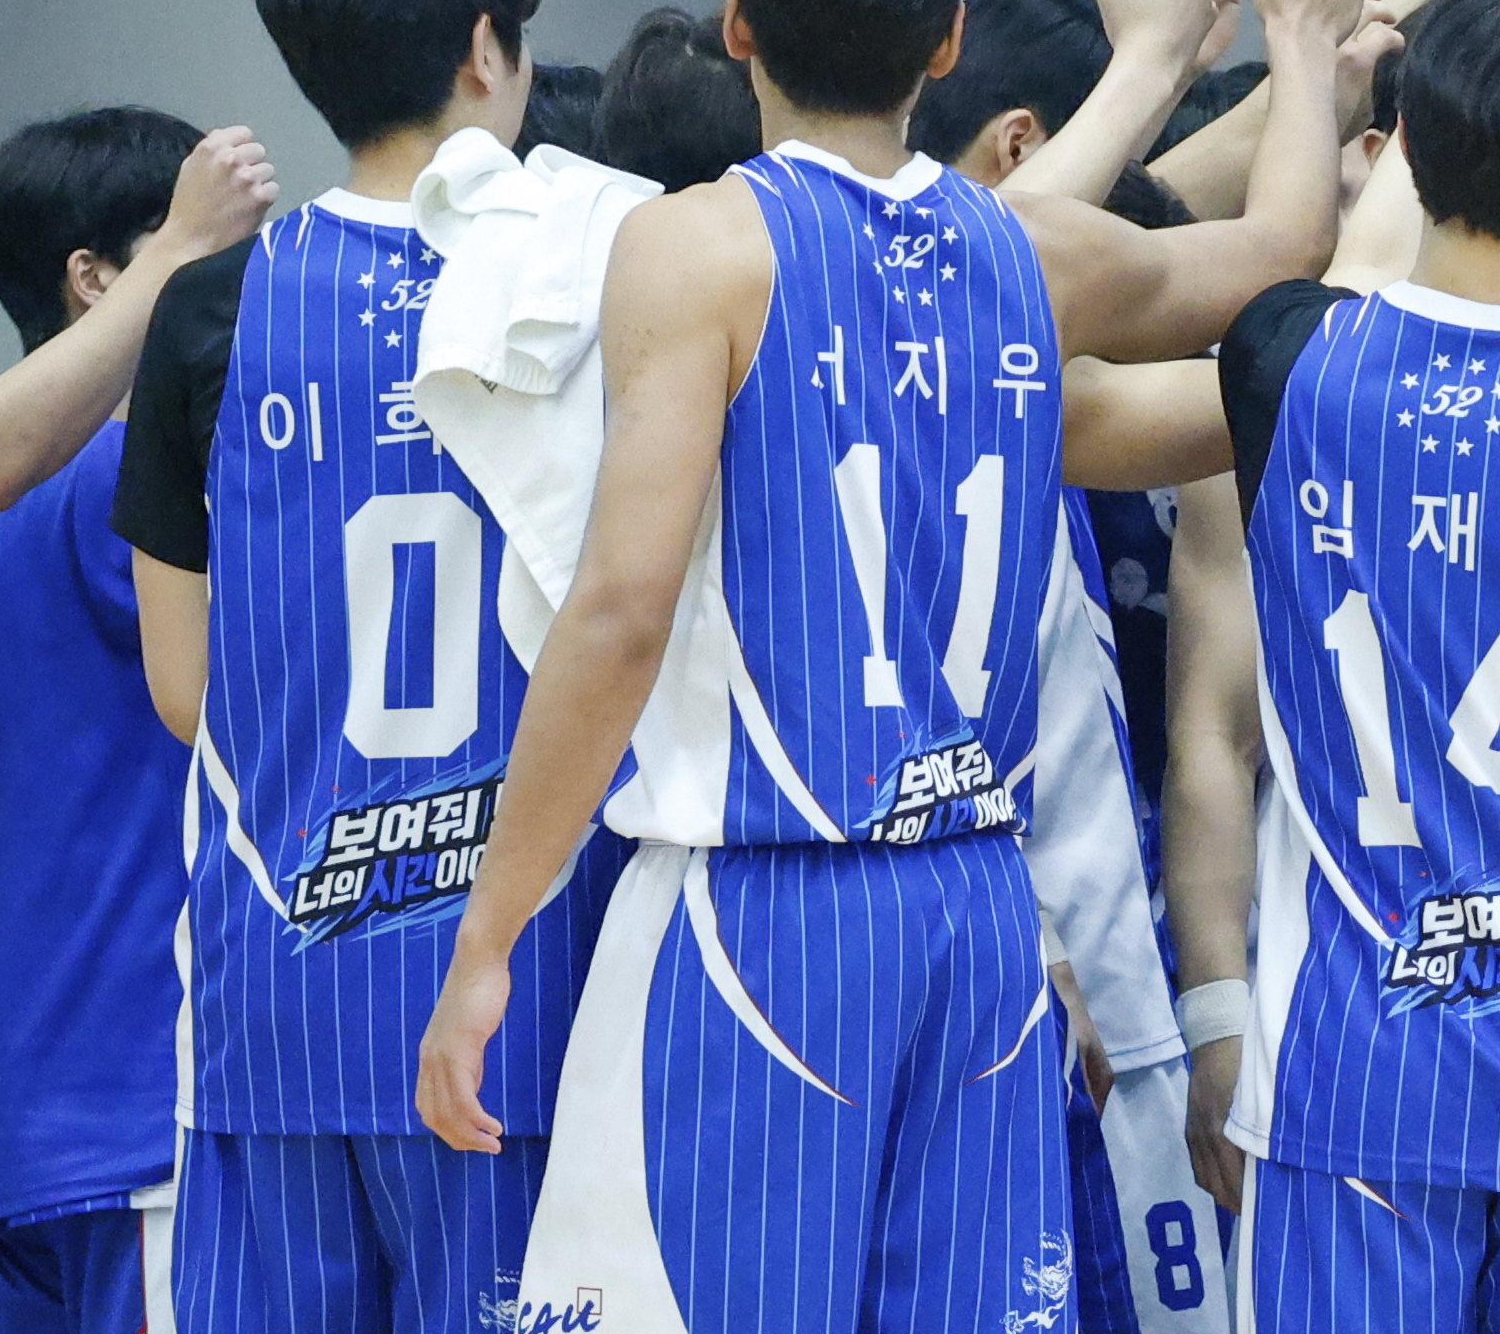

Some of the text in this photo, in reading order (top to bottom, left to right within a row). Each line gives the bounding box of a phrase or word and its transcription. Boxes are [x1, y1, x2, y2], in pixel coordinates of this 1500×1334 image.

[883, 234, 935, 270] 52
[1423, 384, 1482, 419] 52
[834, 443, 1005, 718] 11
[343, 492, 483, 759] 0
[294, 865, 368, 916] 너의
[1391, 945, 1455, 986] 너의
[1146, 1200, 1205, 1312] 8
